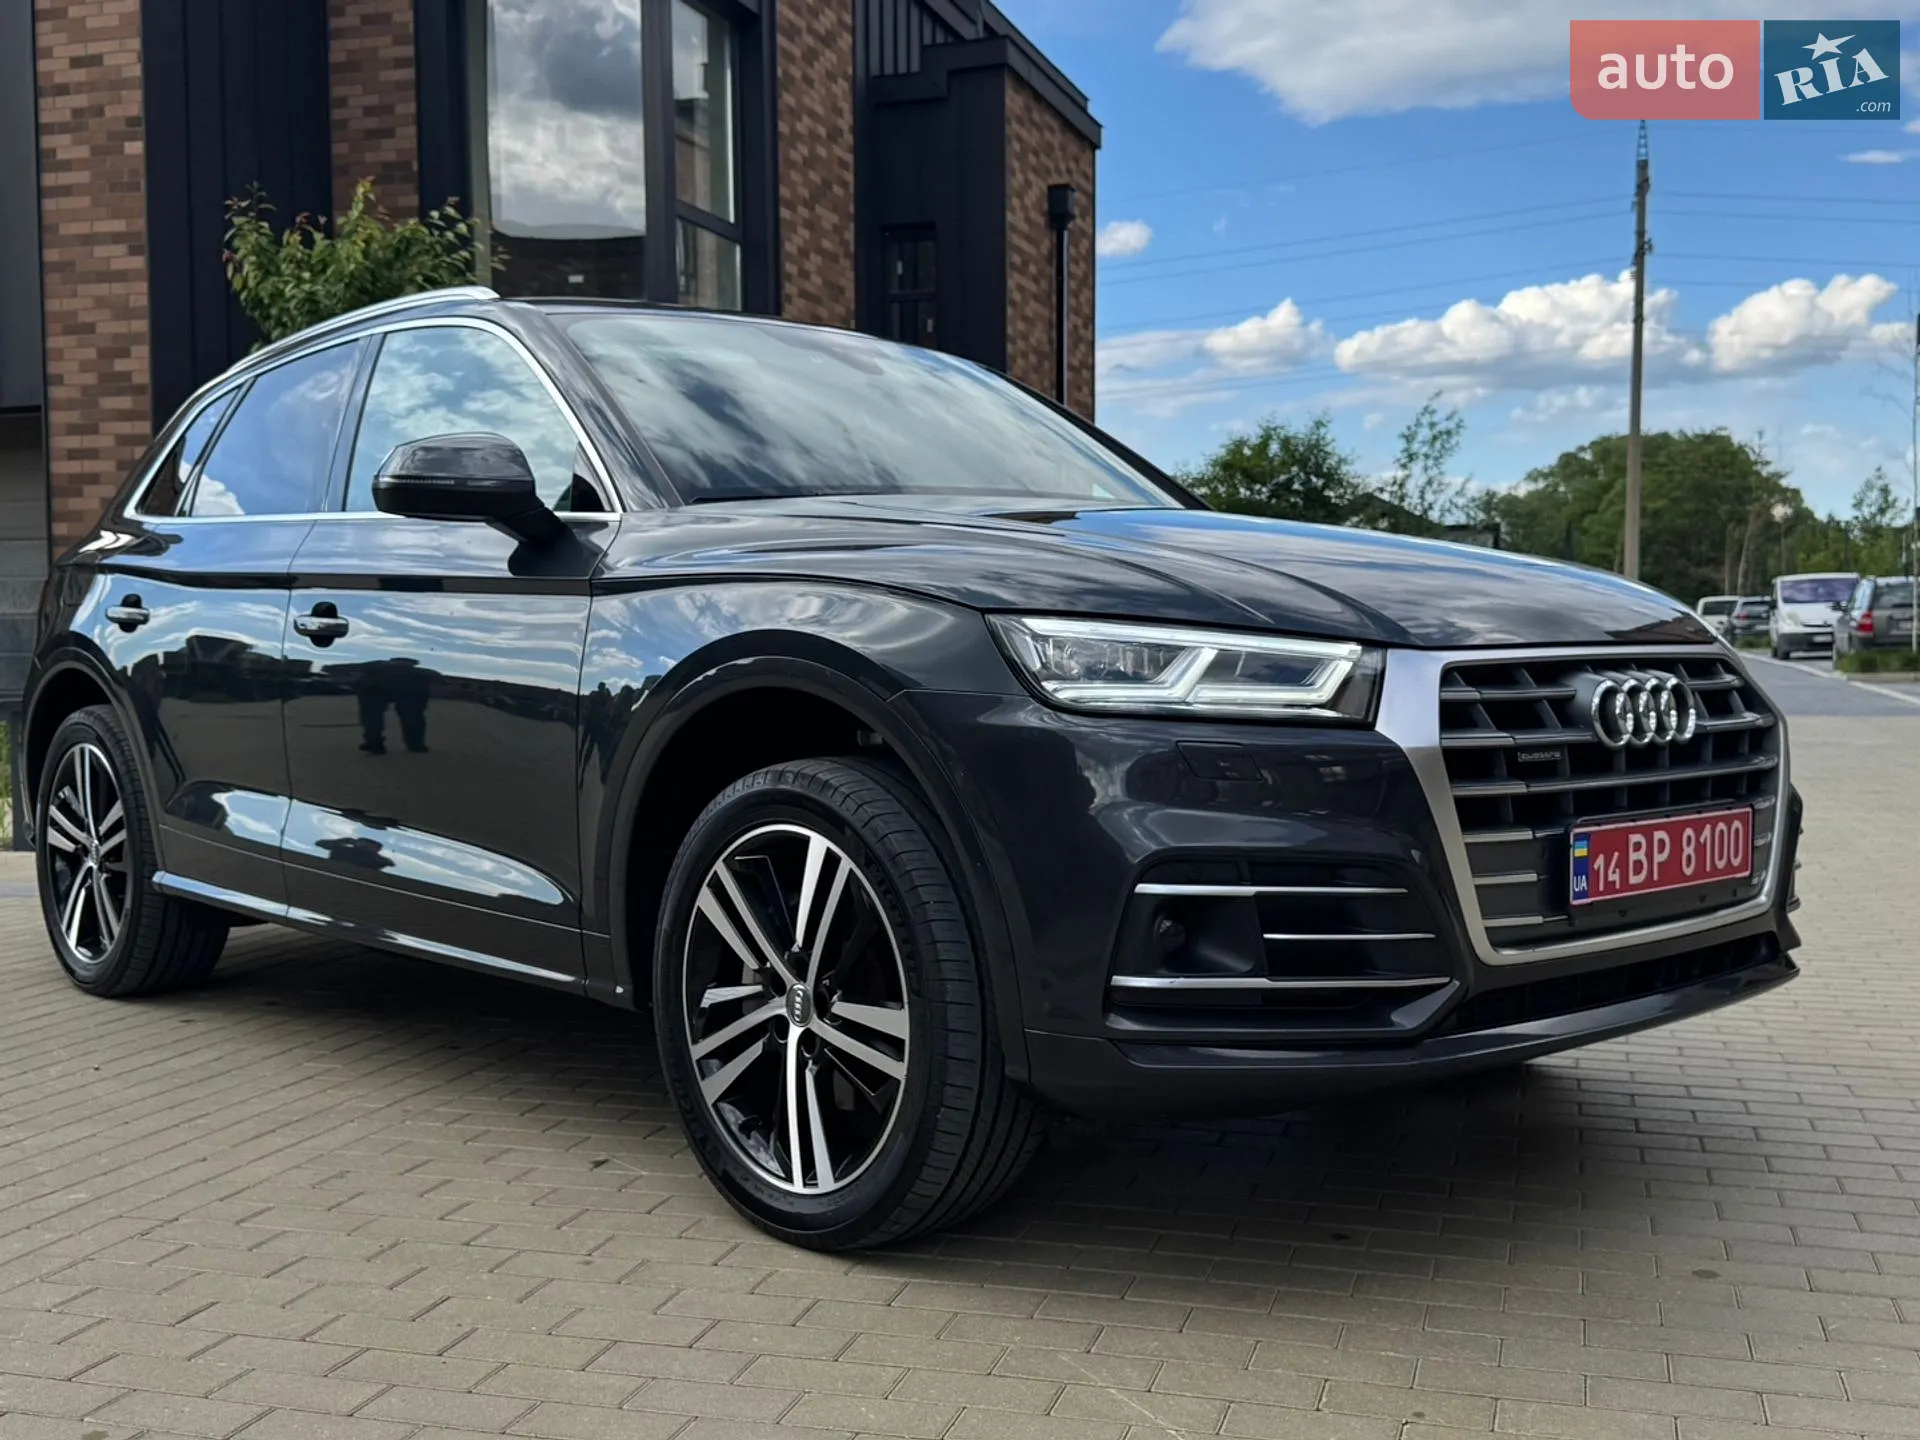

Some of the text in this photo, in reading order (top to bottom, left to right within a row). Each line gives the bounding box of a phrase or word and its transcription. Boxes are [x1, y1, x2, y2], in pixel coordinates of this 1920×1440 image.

[1593, 819, 1744, 892] 14 BP 8100
[1573, 874, 1588, 892] UA
